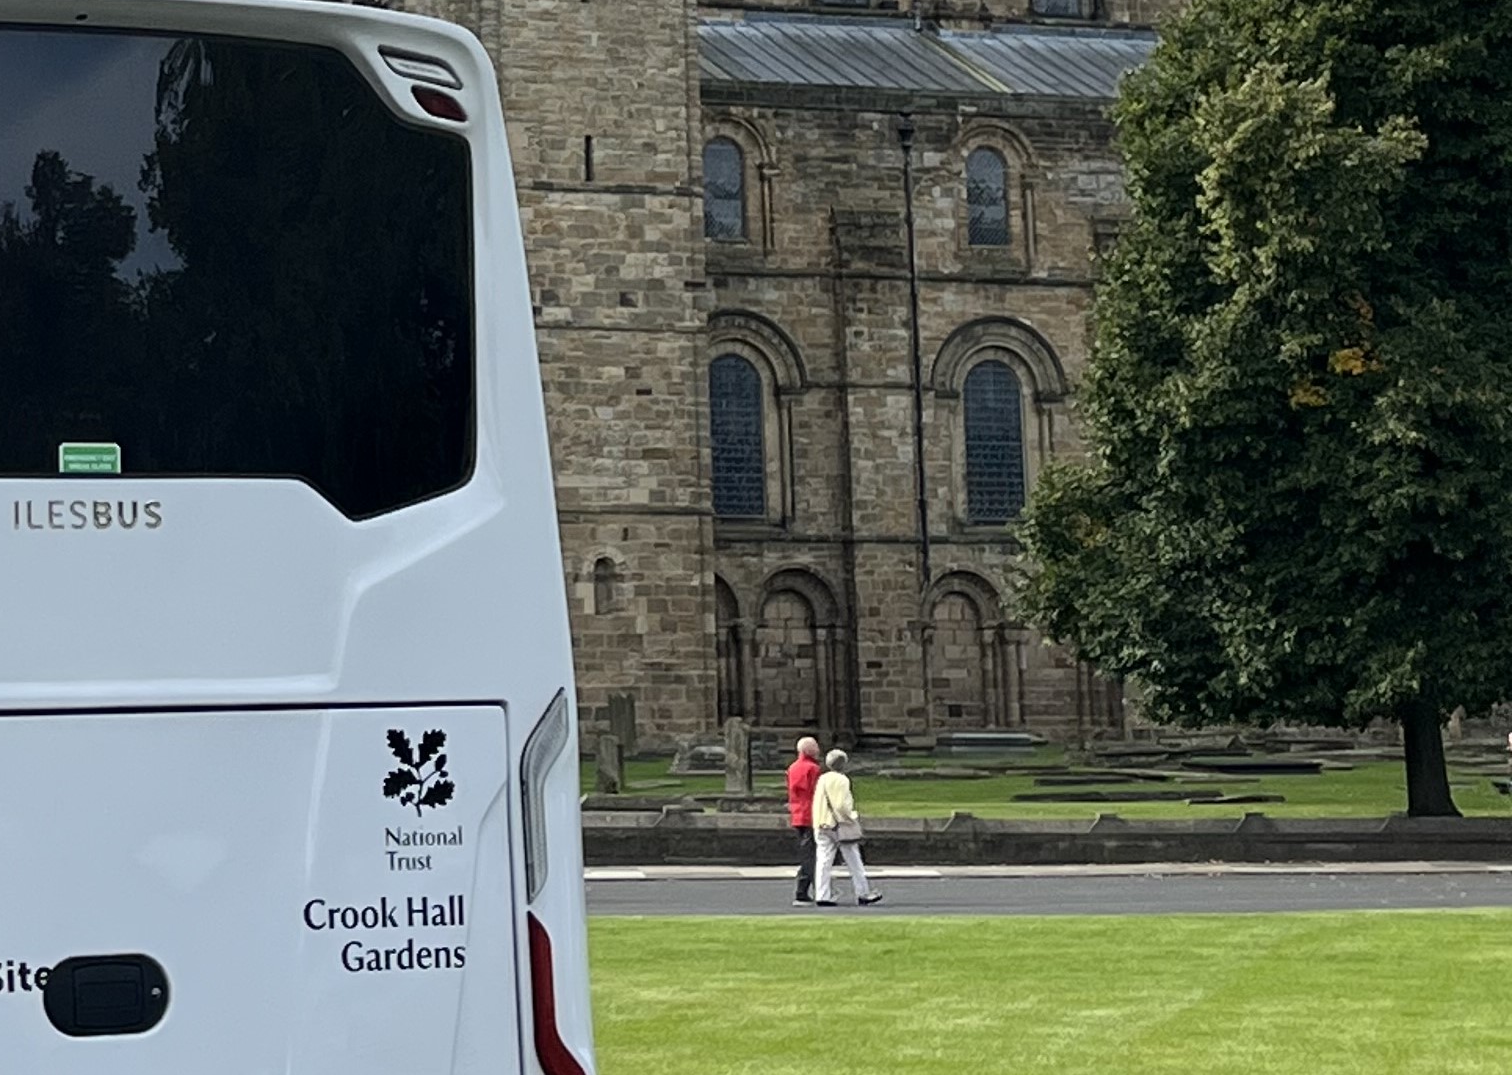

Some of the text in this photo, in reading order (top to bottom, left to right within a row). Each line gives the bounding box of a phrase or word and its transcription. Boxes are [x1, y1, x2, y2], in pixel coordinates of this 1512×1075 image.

[13, 500, 162, 529] ILESBUS
[385, 826, 463, 846] National
[385, 851, 432, 871] Trust
[303, 895, 464, 930] Crook Hall
[341, 938, 466, 972] Gardens
